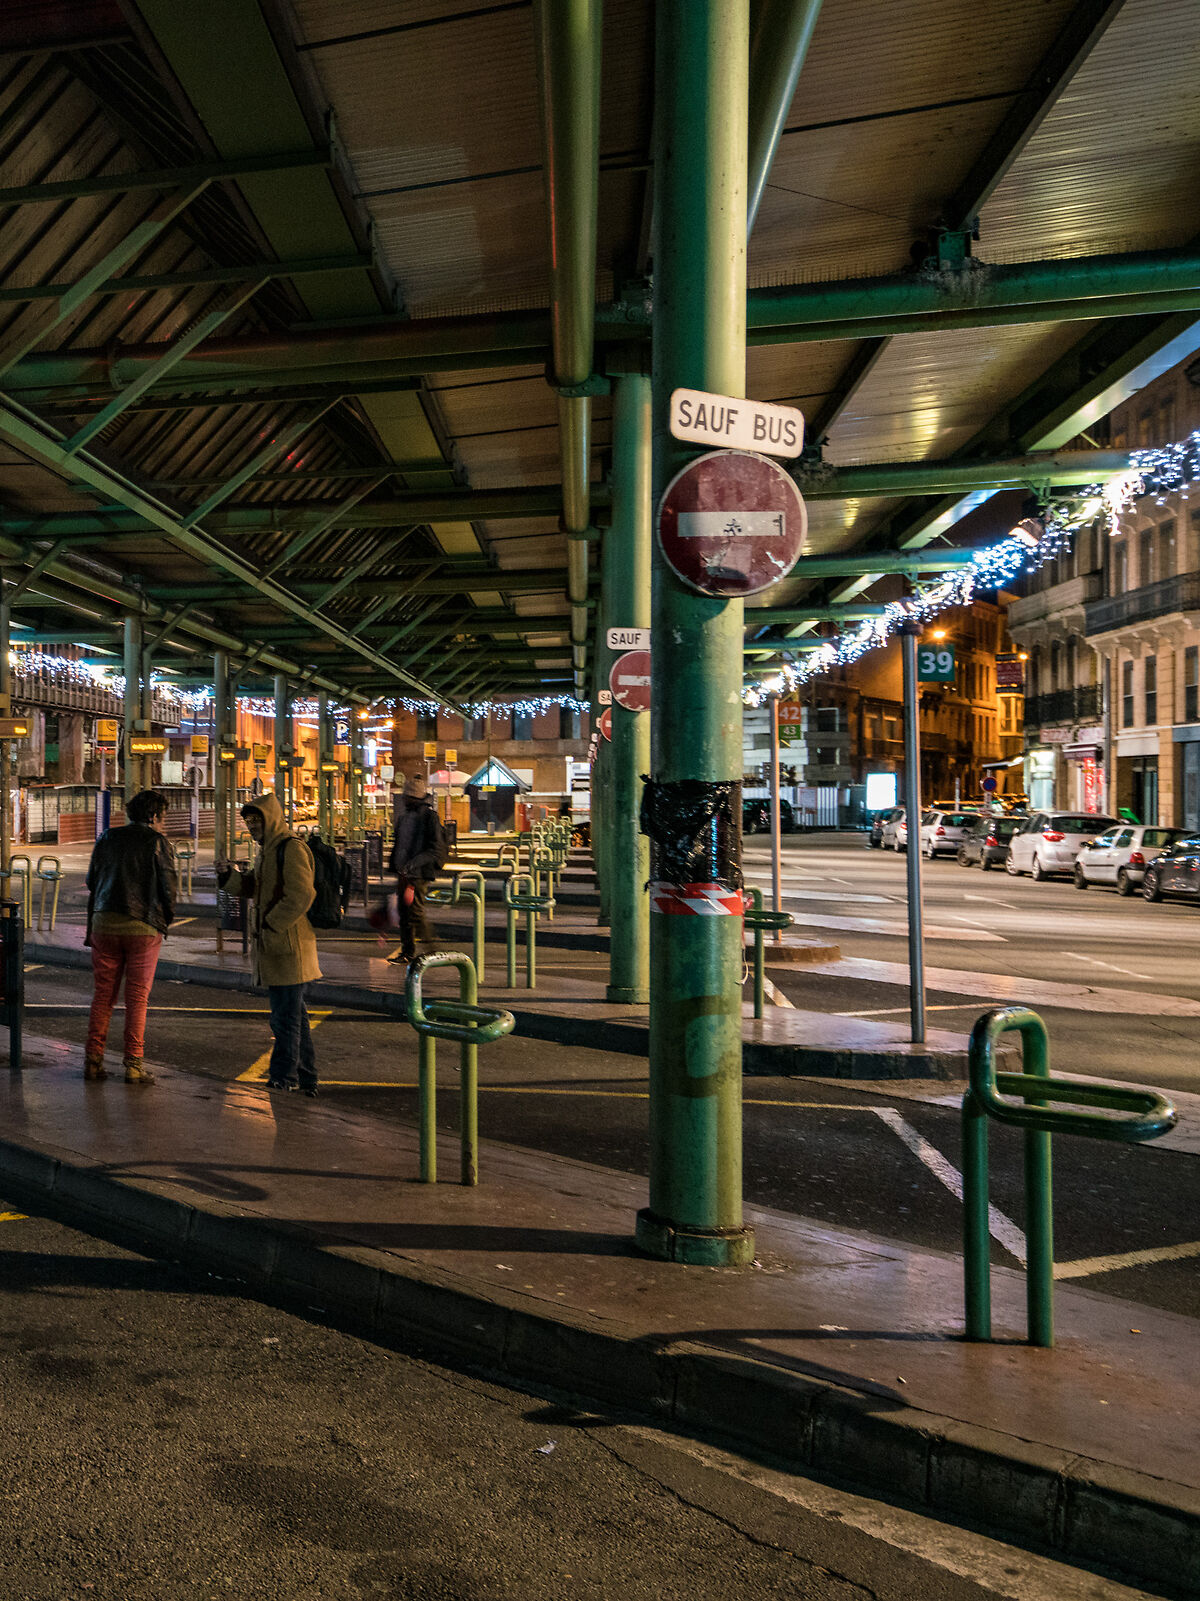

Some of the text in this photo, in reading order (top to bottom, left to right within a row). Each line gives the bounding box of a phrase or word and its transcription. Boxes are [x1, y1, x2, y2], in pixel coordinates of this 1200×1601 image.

[678, 400, 797, 447] SAUF BUS
[611, 632, 641, 645] SAUF
[920, 651, 953, 674] 39
[779, 706, 800, 720] 42
[783, 726, 797, 735] 43
